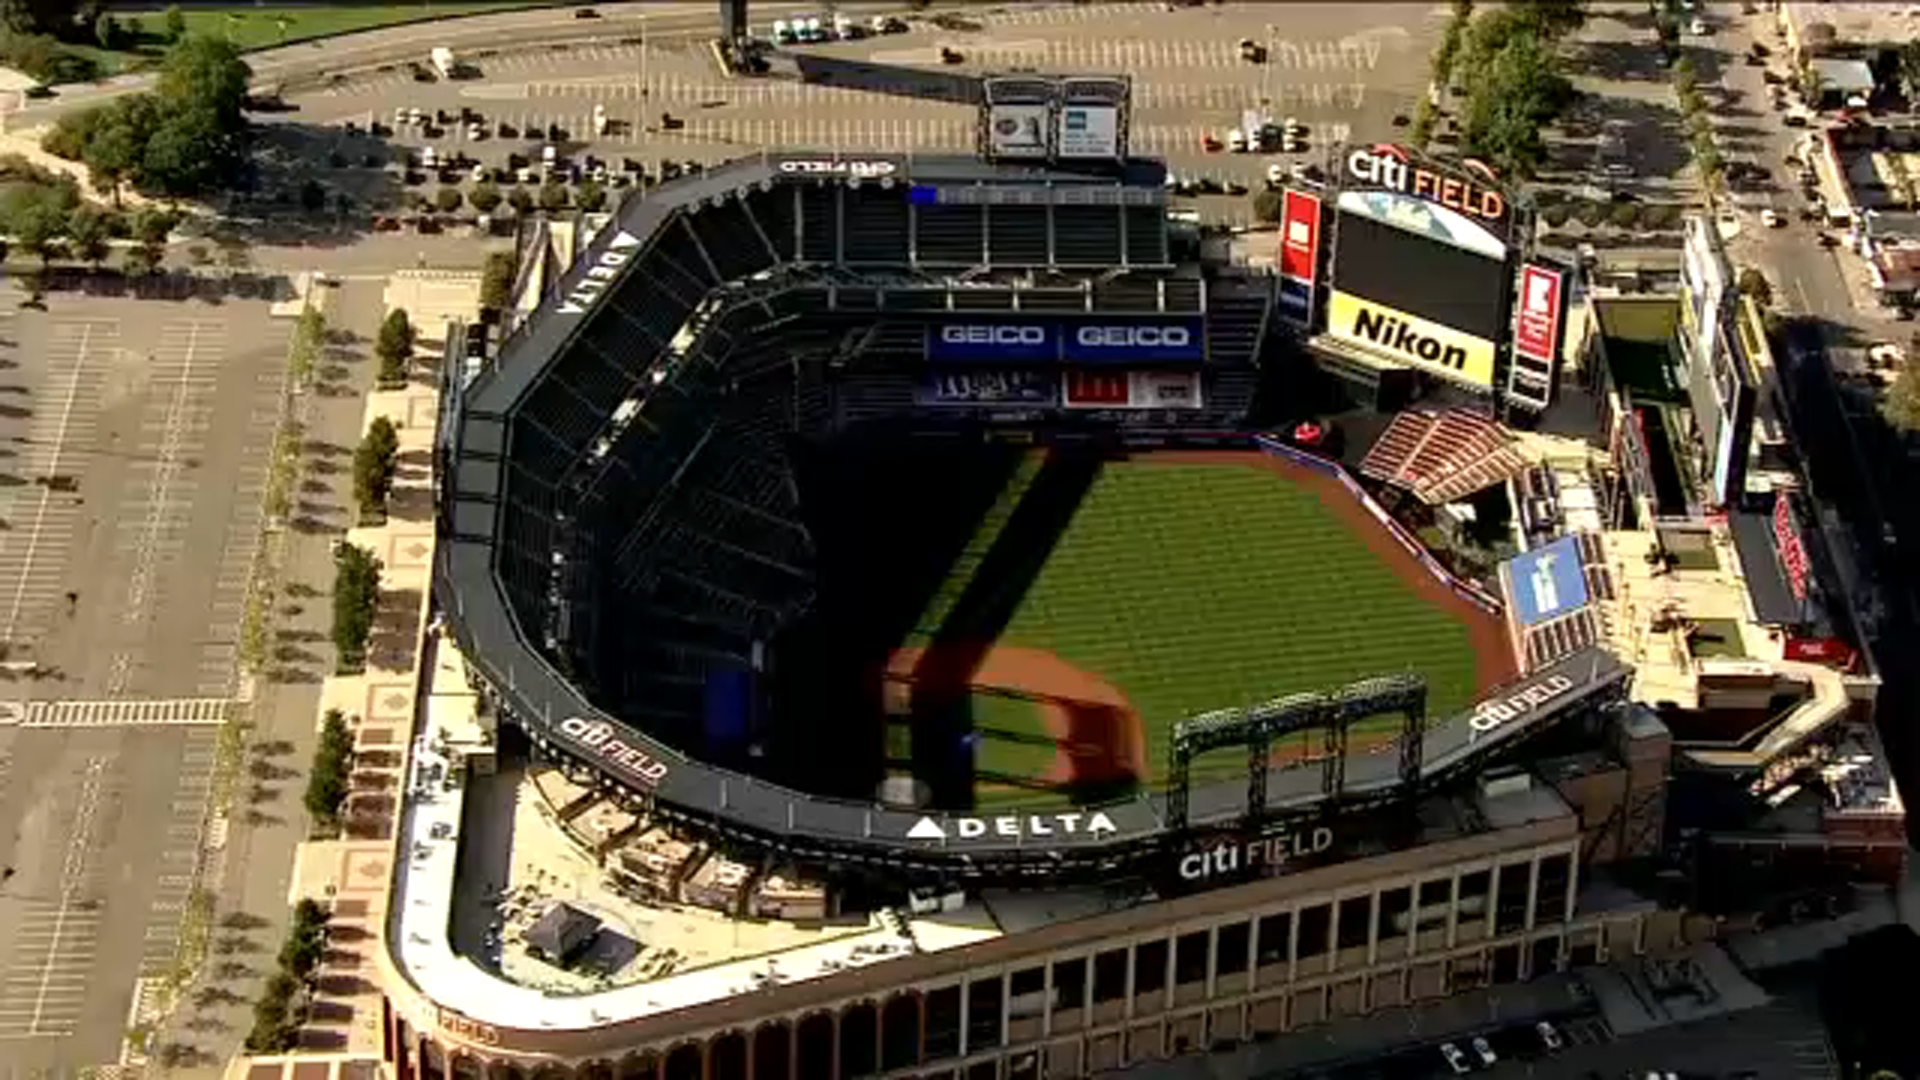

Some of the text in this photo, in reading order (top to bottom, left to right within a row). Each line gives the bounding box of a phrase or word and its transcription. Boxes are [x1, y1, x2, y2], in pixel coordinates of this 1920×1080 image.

[1349, 150, 1504, 217] citi FIELD
[555, 251, 628, 313] DELTA
[941, 325, 1045, 344] GEICO
[1077, 325, 1190, 346] GEICO
[1353, 308, 1467, 370] Nikon
[1508, 675, 1573, 713] FIELD
[600, 740, 668, 779] FIELD
[958, 812, 1117, 838] DELTA
[1179, 826, 1334, 879] citi FIELD
